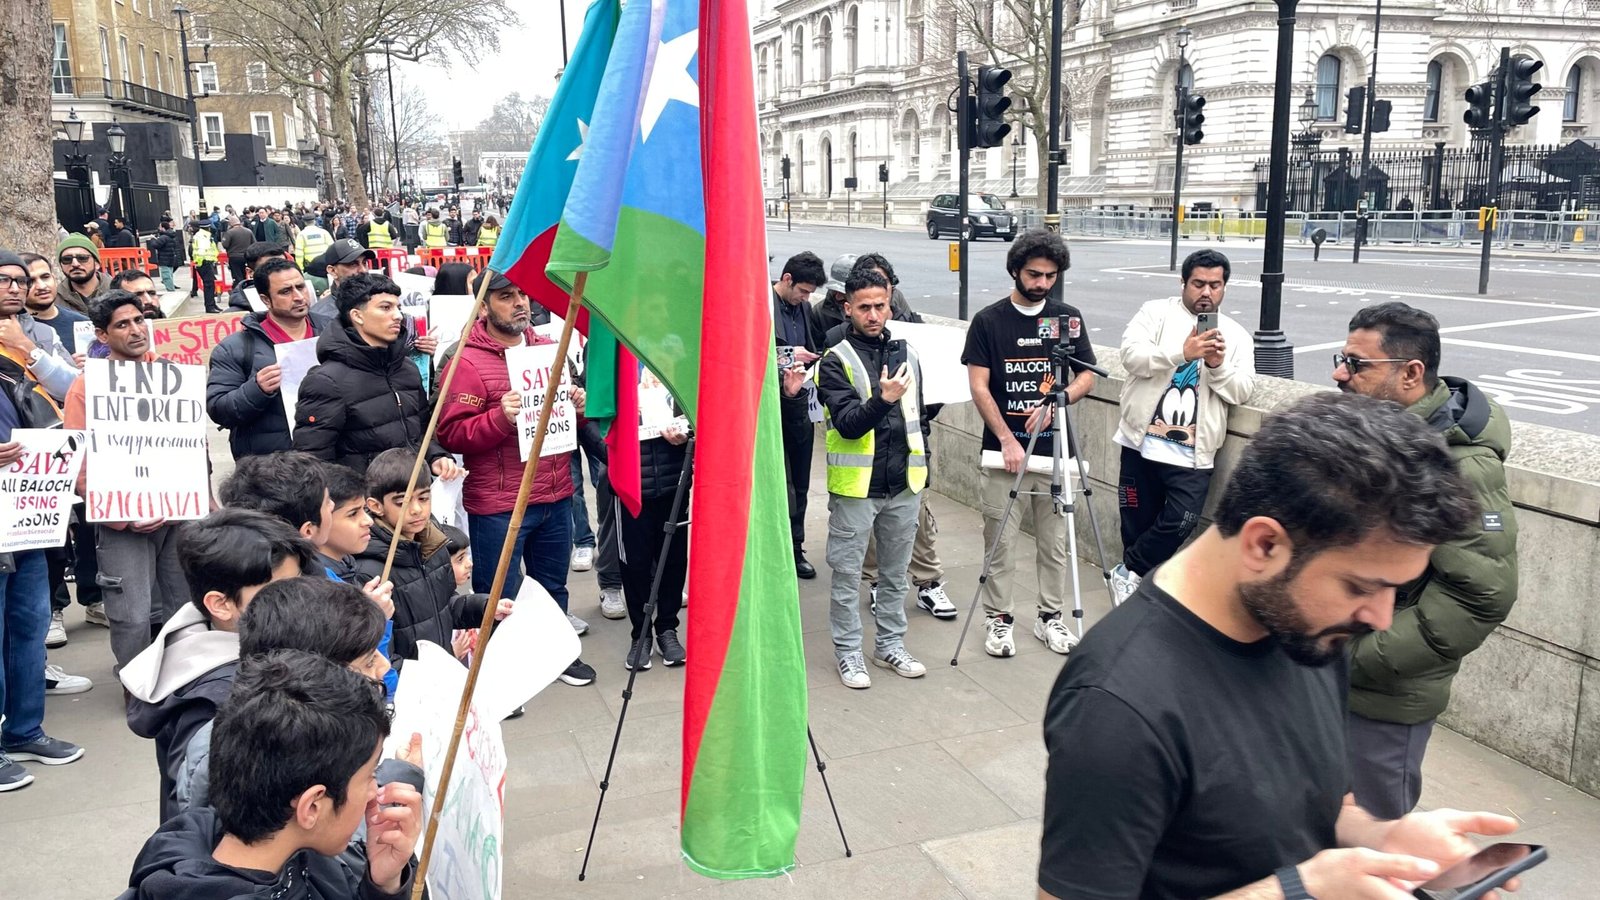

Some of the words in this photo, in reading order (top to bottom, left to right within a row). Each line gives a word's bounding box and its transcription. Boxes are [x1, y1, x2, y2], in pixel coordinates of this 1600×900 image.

[161, 352, 202, 365] IGHTS
[1005, 362, 1051, 374] BALOCH
[108, 359, 182, 395] END
[1006, 381, 1037, 392] LIVES
[533, 390, 572, 407] BAOCH
[1008, 399, 1039, 410] MAT
[93, 395, 203, 423] ENFORCED
[525, 405, 565, 423] MISNG
[525, 420, 570, 439] PEONS
[10, 452, 73, 475] SAVE
[1, 478, 17, 493] All
[20, 479, 73, 493] BALOCH
[14, 496, 58, 510] ISSING
[1127, 487, 1138, 508] LOVE
[12, 512, 60, 528] RSONS
